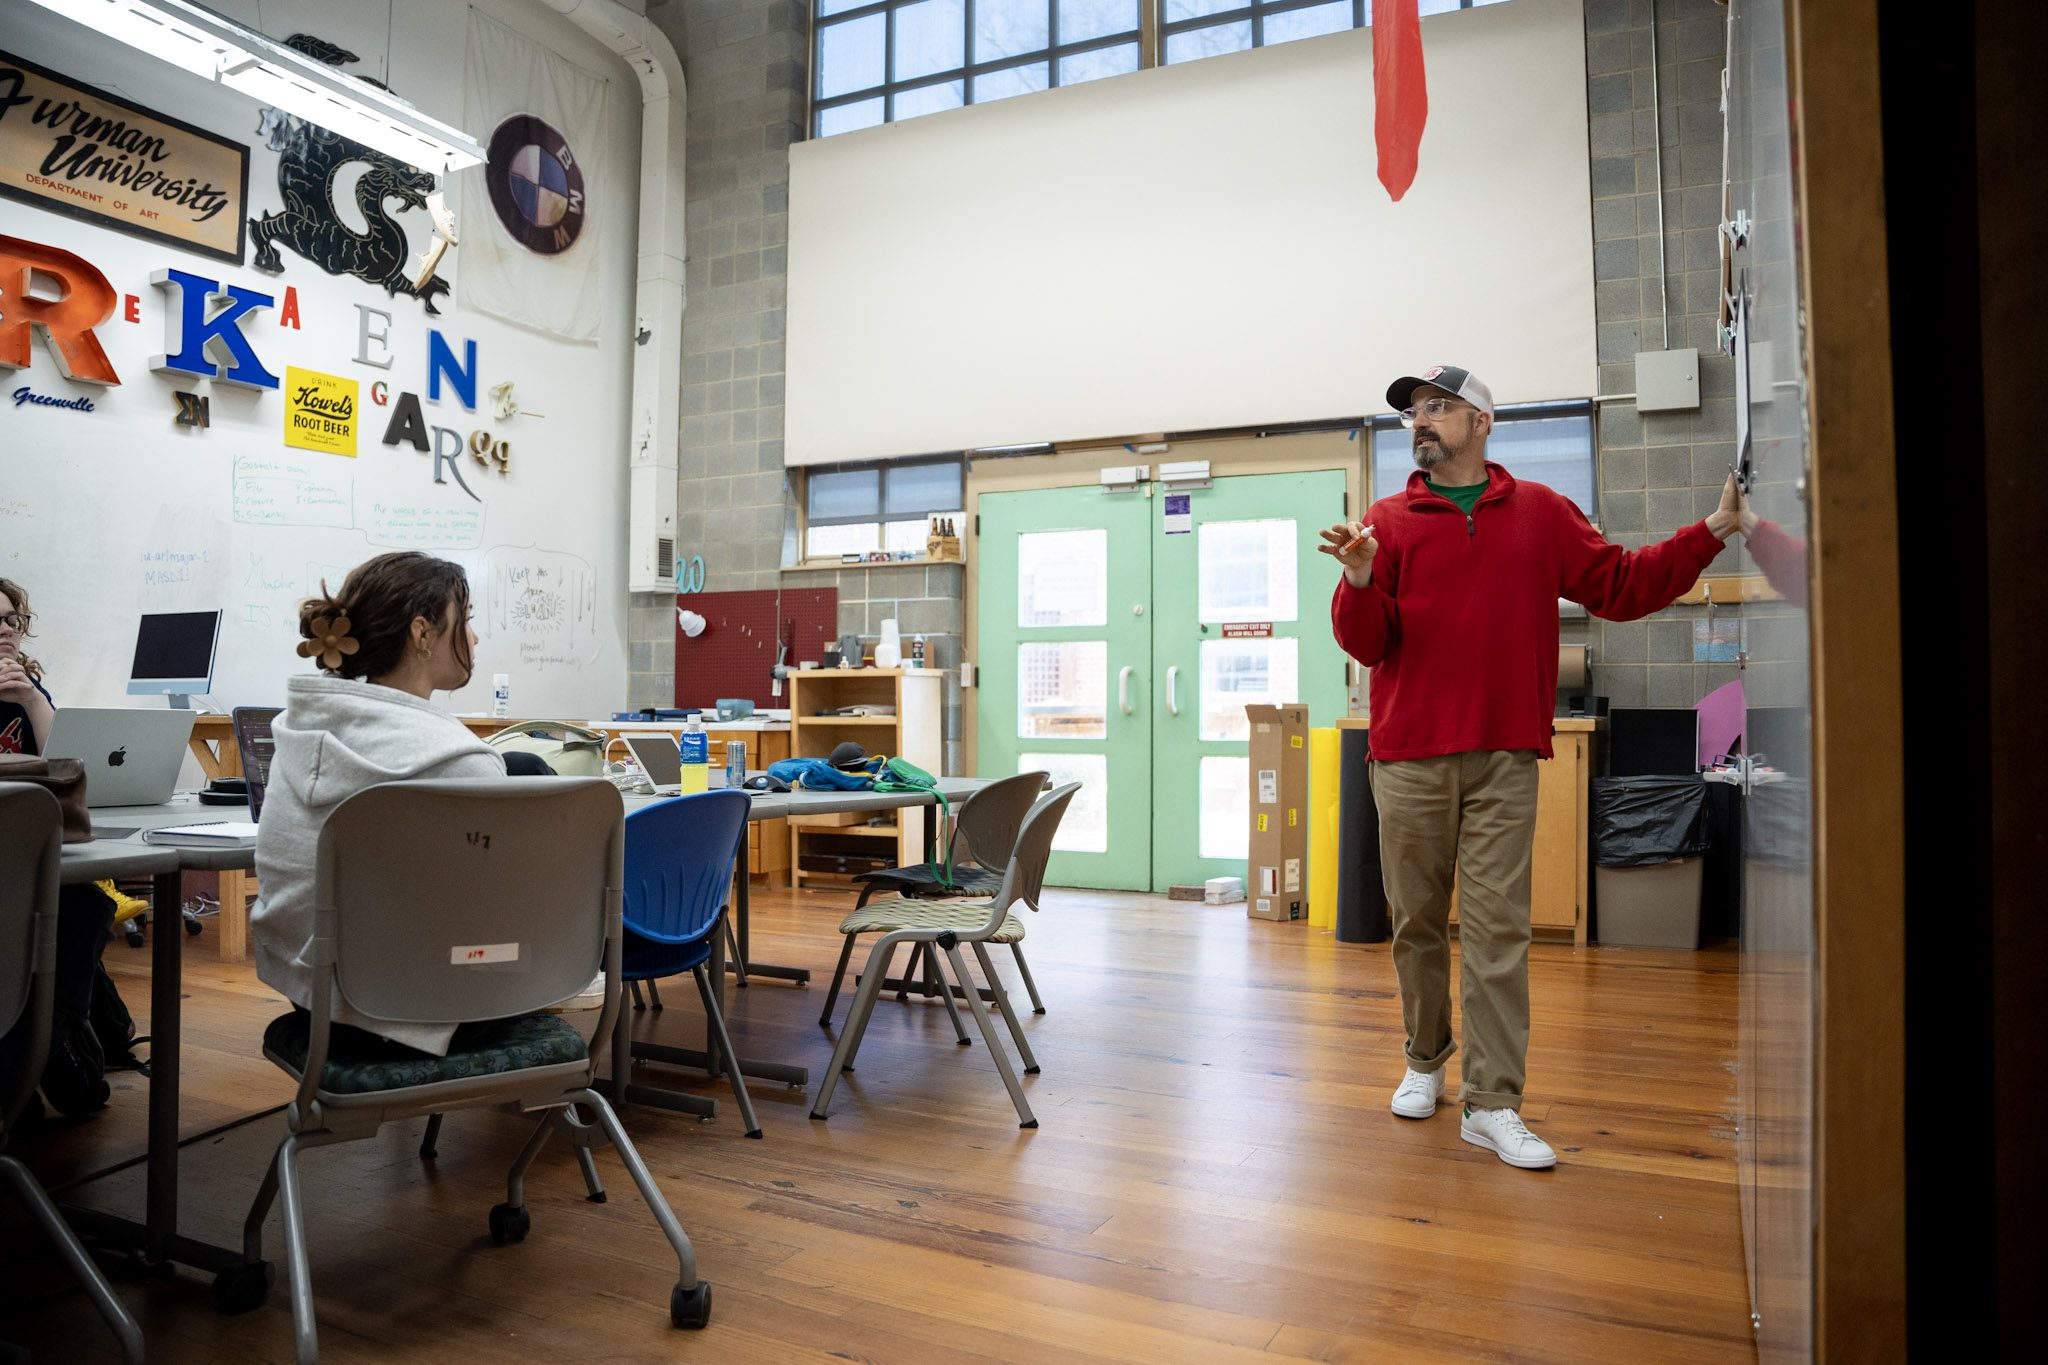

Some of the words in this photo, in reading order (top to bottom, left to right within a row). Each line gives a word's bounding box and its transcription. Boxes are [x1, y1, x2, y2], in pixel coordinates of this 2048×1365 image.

[26, 173, 104, 204] DEPARTMENT
[113, 200, 129, 212] OF
[139, 209, 160, 221] ART
[40, 135, 229, 222] University
[0, 233, 122, 387] R
[125, 293, 140, 324] E
[150, 268, 280, 391] K
[280, 285, 301, 330] A
[351, 303, 394, 370] E
[311, 377, 338, 389] DRINK
[371, 381, 388, 406] G
[426, 327, 478, 413] N
[12, 387, 96, 413] Greenville
[293, 386, 353, 415] Howel's
[382, 391, 431, 452] A
[294, 414, 322, 431] ROOT
[323, 420, 350, 437] BEER
[430, 424, 482, 503] R
